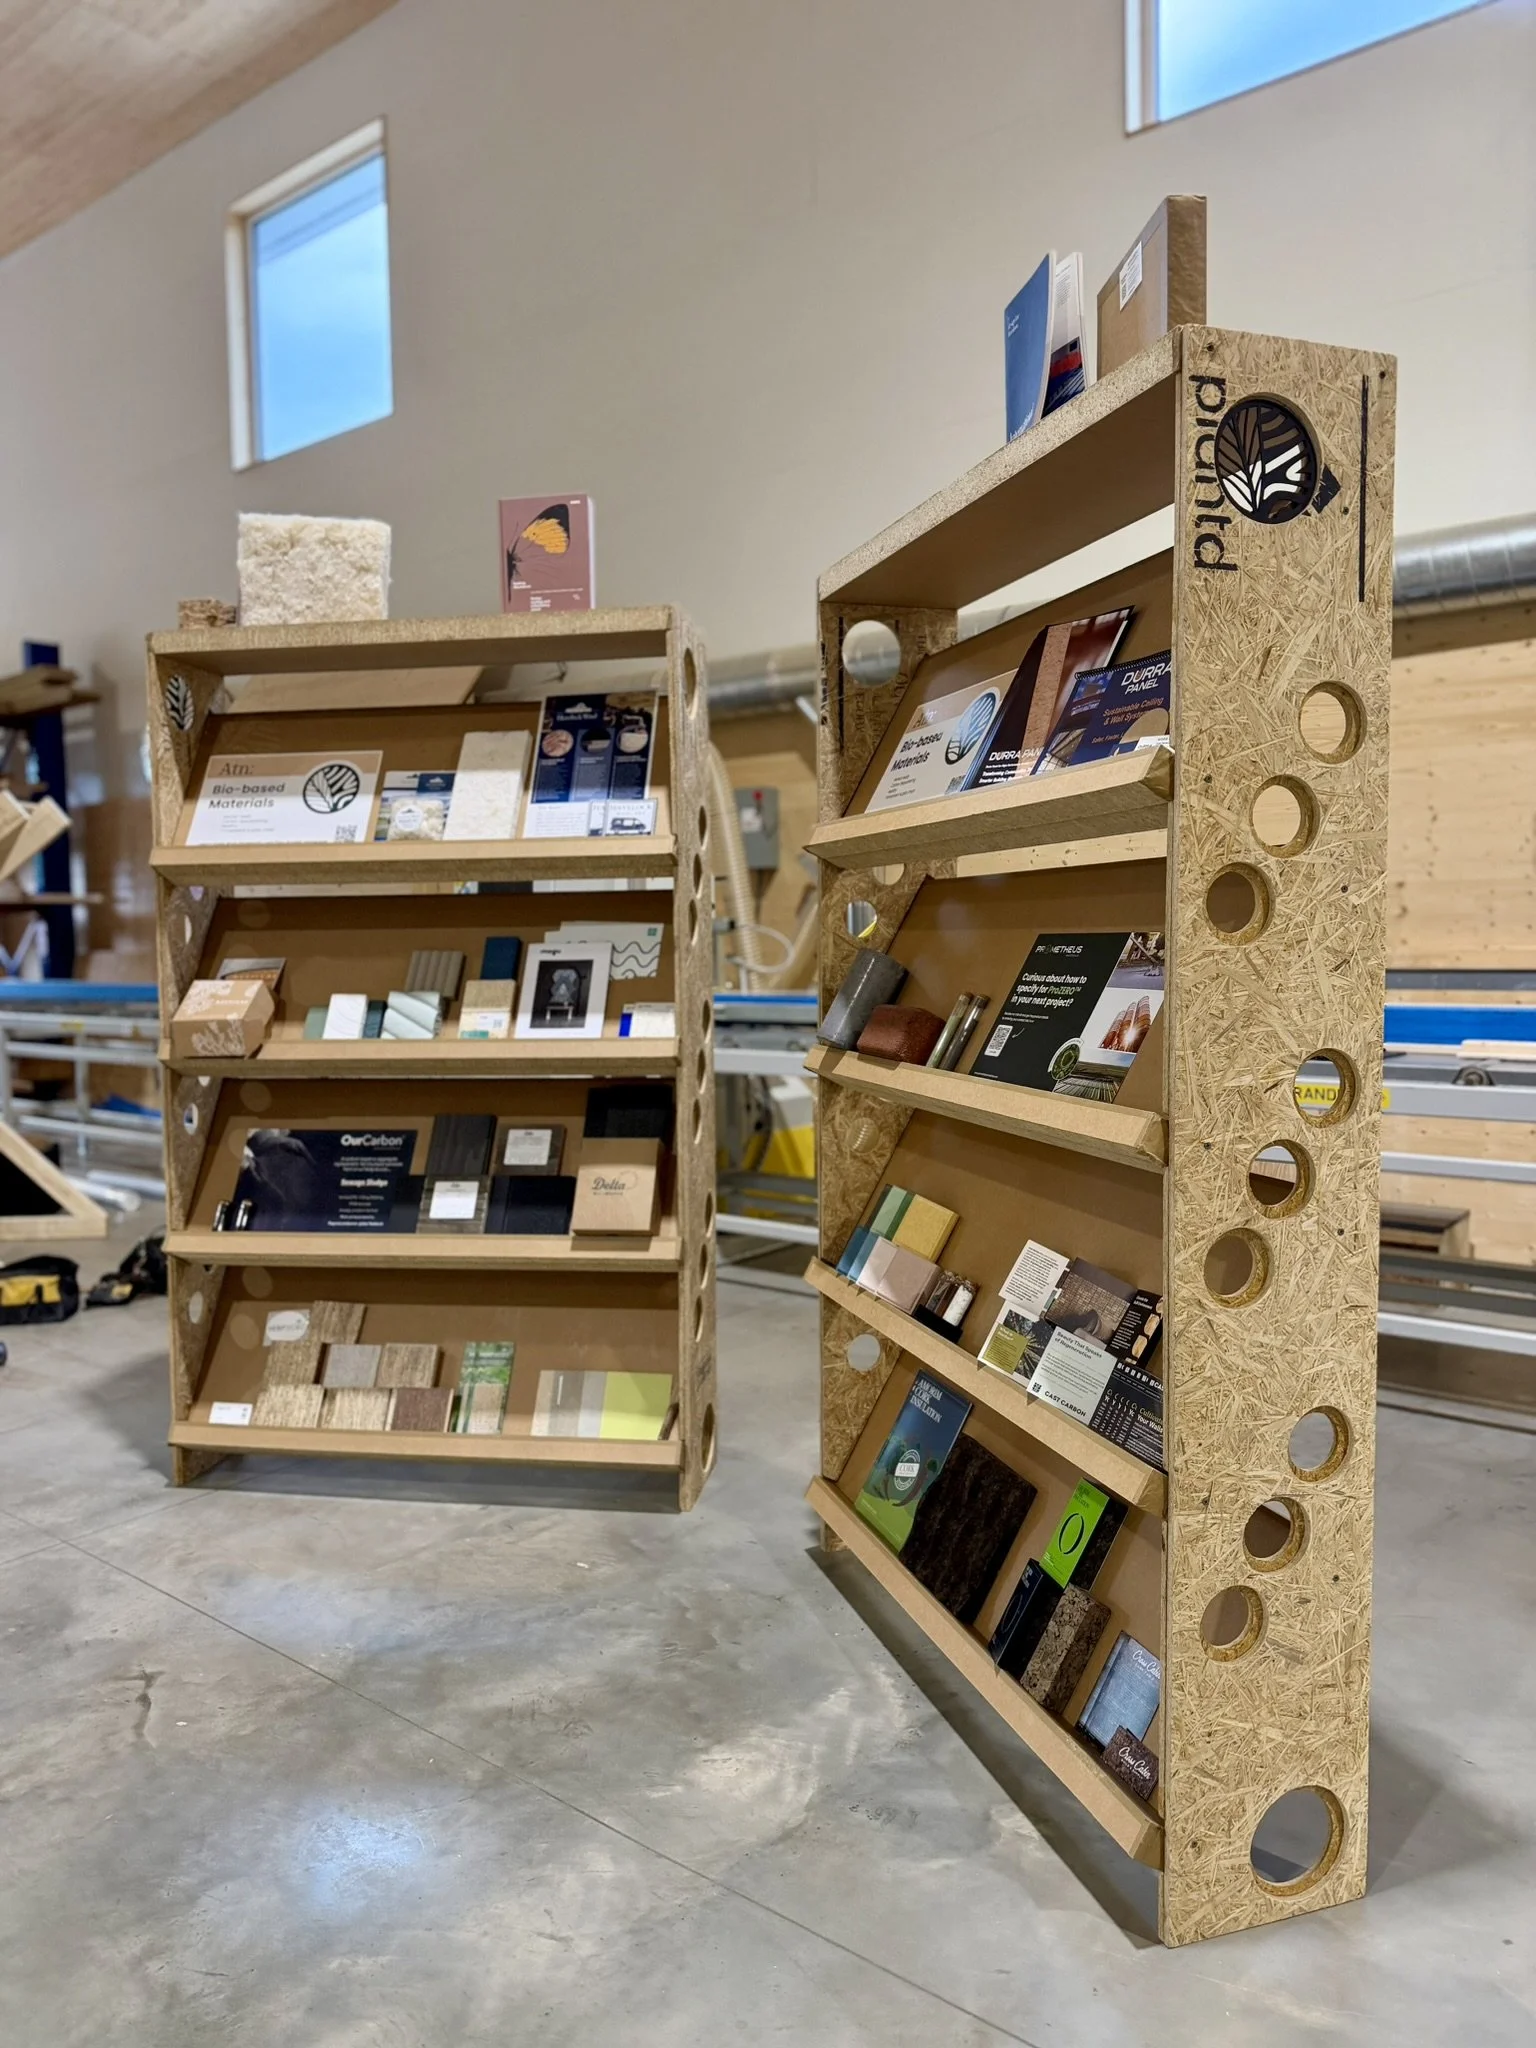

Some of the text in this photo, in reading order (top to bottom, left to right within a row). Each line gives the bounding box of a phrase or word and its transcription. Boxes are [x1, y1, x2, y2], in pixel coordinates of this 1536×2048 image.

[1189, 375, 1239, 572] plantd
[1121, 662, 1172, 686] DURRA
[1125, 679, 1159, 695] PANEL
[1103, 702, 1141, 717] Sustainable
[1141, 697, 1164, 708] Ceiling
[1110, 714, 1125, 725] Wall
[900, 732, 944, 753] Bio-based
[891, 751, 930, 771] Materials
[989, 750, 1021, 761] DURRA
[219, 762, 255, 776] Atn:
[212, 782, 286, 796] Bio-based
[208, 797, 275, 809] Materials
[1022, 972, 1087, 984] Curious about how to
[1016, 984, 1039, 995] specify
[1038, 984, 1049, 994] for
[1011, 994, 1074, 1008] in your next project?
[341, 1134, 403, 1146] OurCarbon
[592, 1176, 626, 1190] Delta
[1074, 1340, 1085, 1350] That
[914, 1387, 932, 1404] CORK
[917, 1379, 943, 1401] AMORIM
[910, 1395, 942, 1423] INSULATION
[1044, 1390, 1087, 1417] CAST CARBON
[1137, 1414, 1150, 1426] Your
